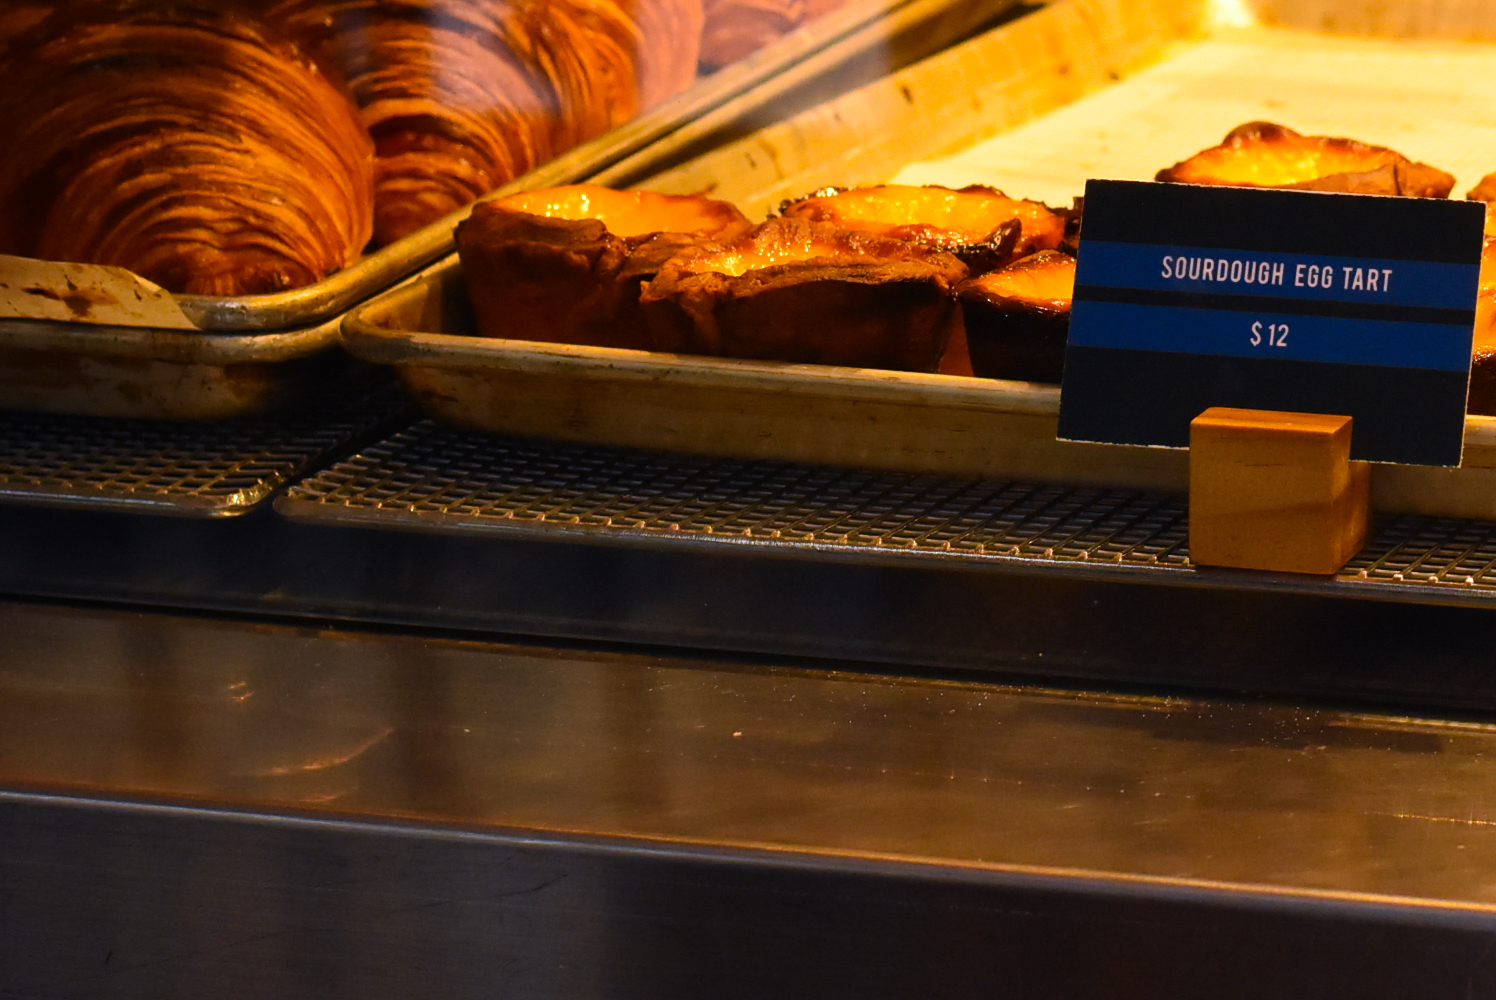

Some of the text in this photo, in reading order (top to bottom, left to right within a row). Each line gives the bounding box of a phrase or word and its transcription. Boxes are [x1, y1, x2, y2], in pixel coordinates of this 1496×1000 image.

[1161, 255, 1393, 292] SOURDOUGH EGG TART
